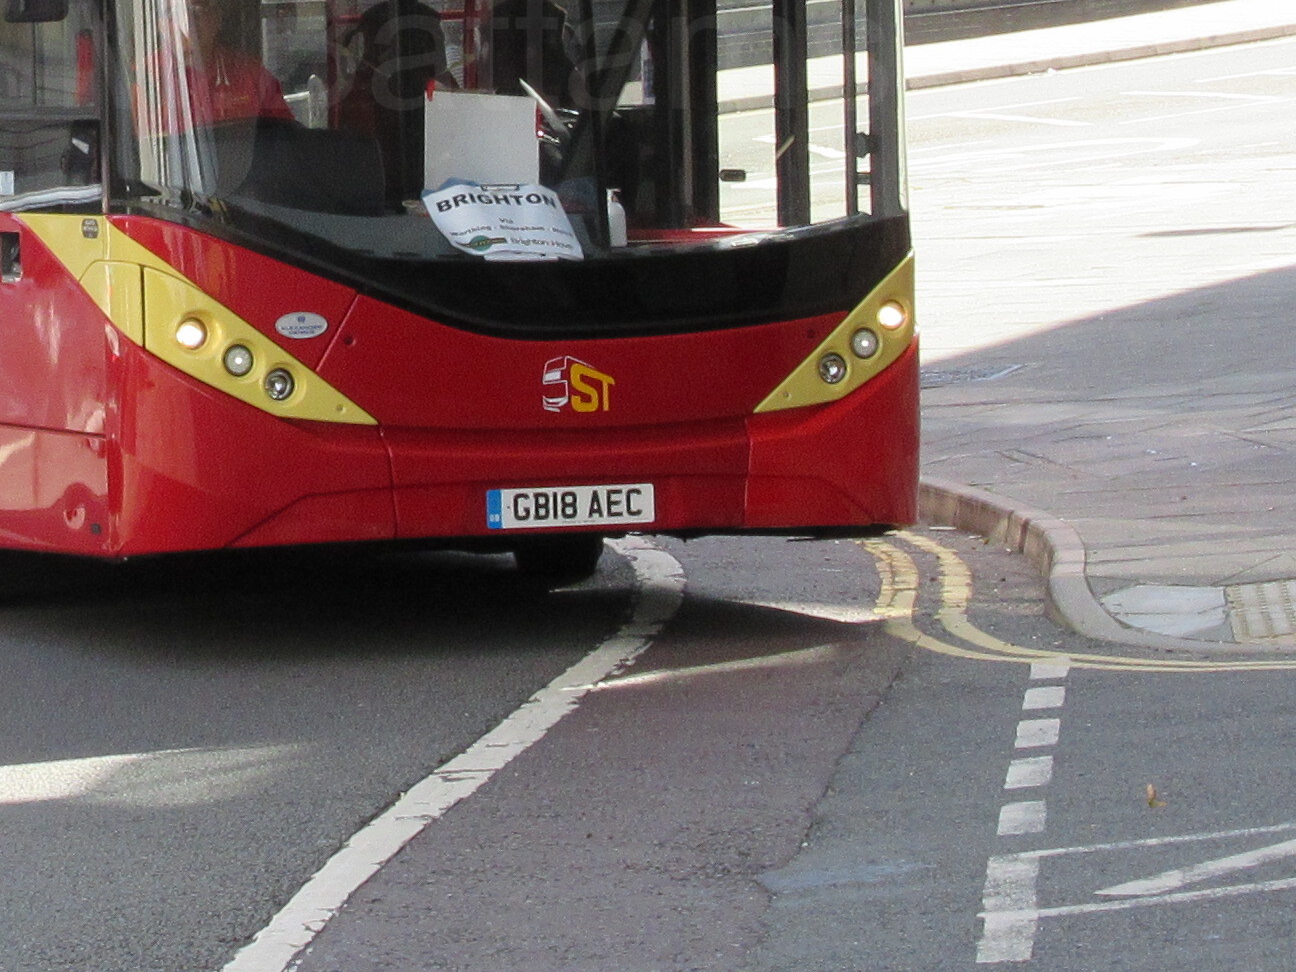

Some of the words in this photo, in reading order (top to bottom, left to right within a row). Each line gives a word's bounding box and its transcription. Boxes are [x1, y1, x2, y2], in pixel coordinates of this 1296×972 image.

[436, 193, 557, 213] BRIGHTON
[570, 363, 615, 412] ST
[513, 491, 577, 521] GB18
[588, 488, 642, 518] AEC
